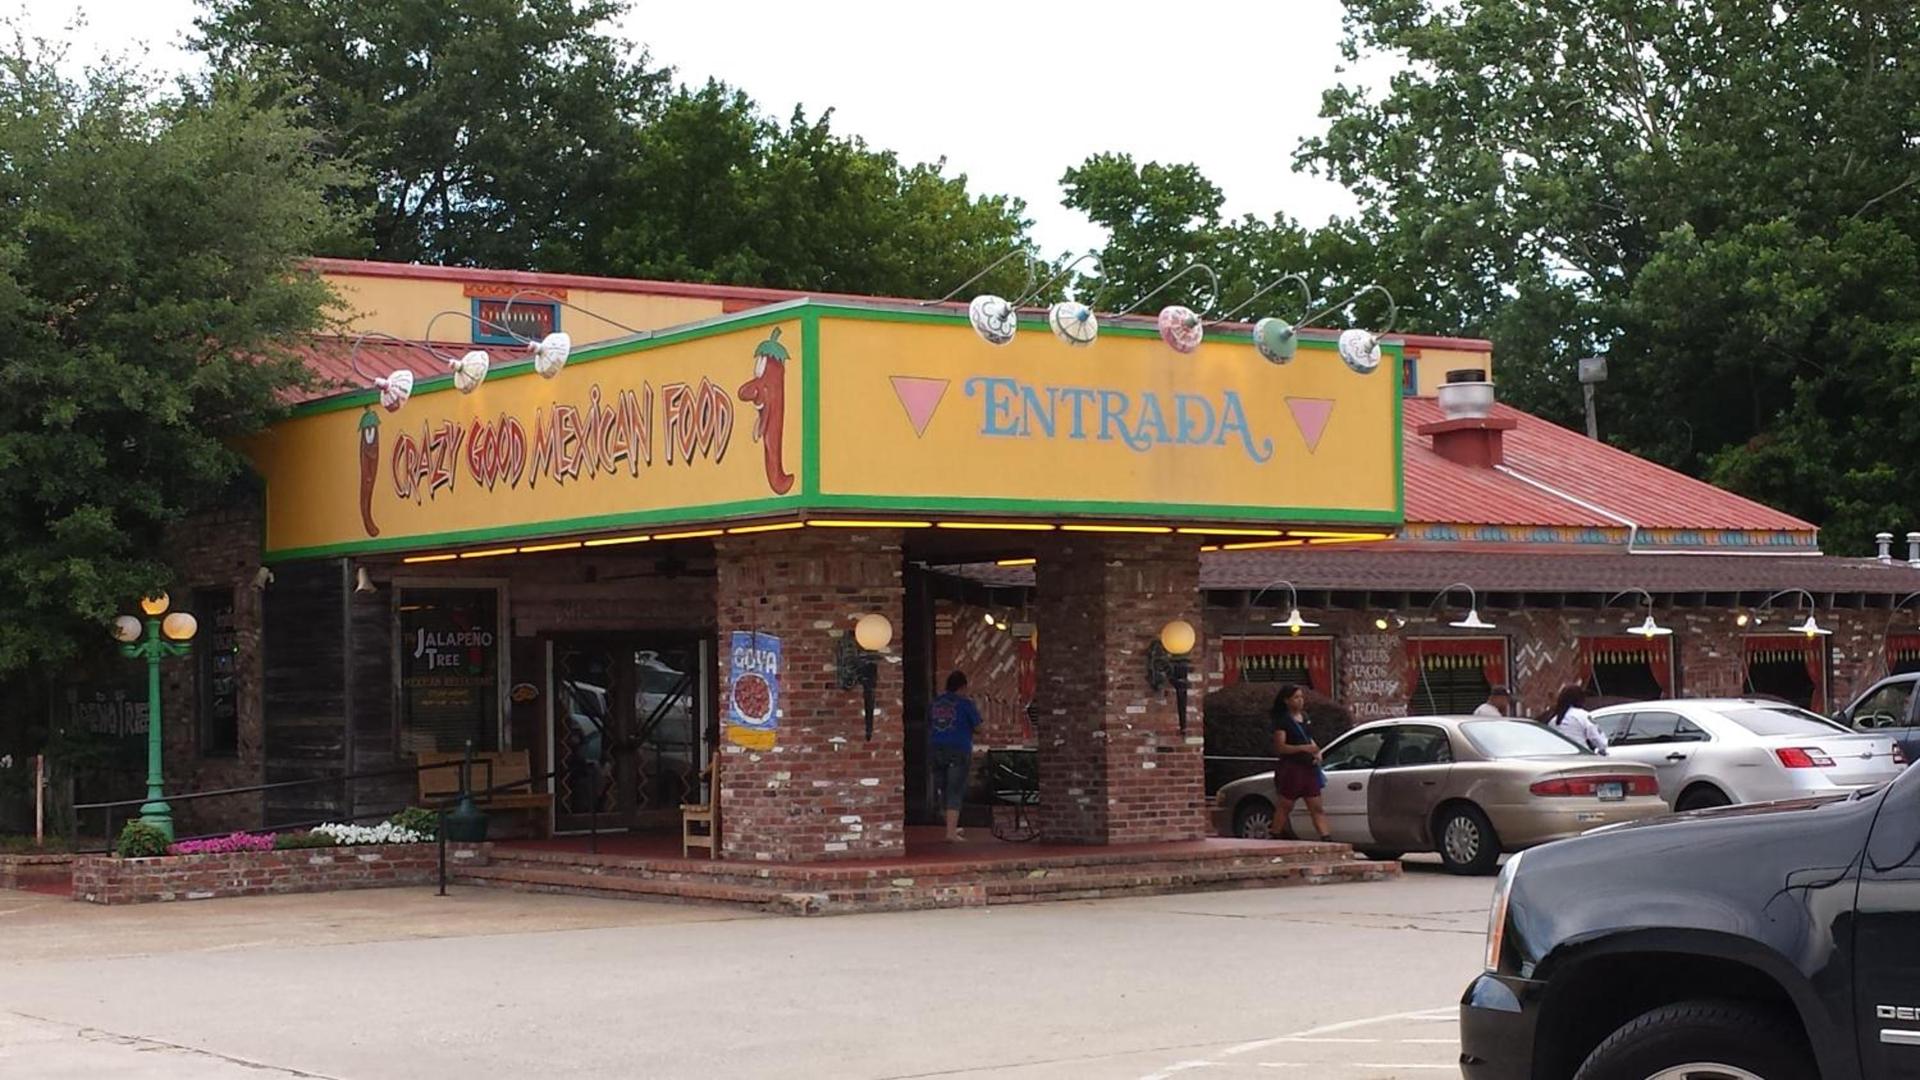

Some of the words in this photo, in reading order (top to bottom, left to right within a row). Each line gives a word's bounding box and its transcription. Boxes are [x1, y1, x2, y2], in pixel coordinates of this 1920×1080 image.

[964, 376, 1274, 464] ENTRADA
[392, 419, 466, 506] CRAZY
[467, 412, 527, 493] GOOD
[661, 376, 734, 466] FOOD
[414, 627, 492, 658] JALAPEÑO
[425, 648, 460, 670] TREE
[734, 646, 777, 675] GOYA
[1876, 1005, 1920, 1020] DE
